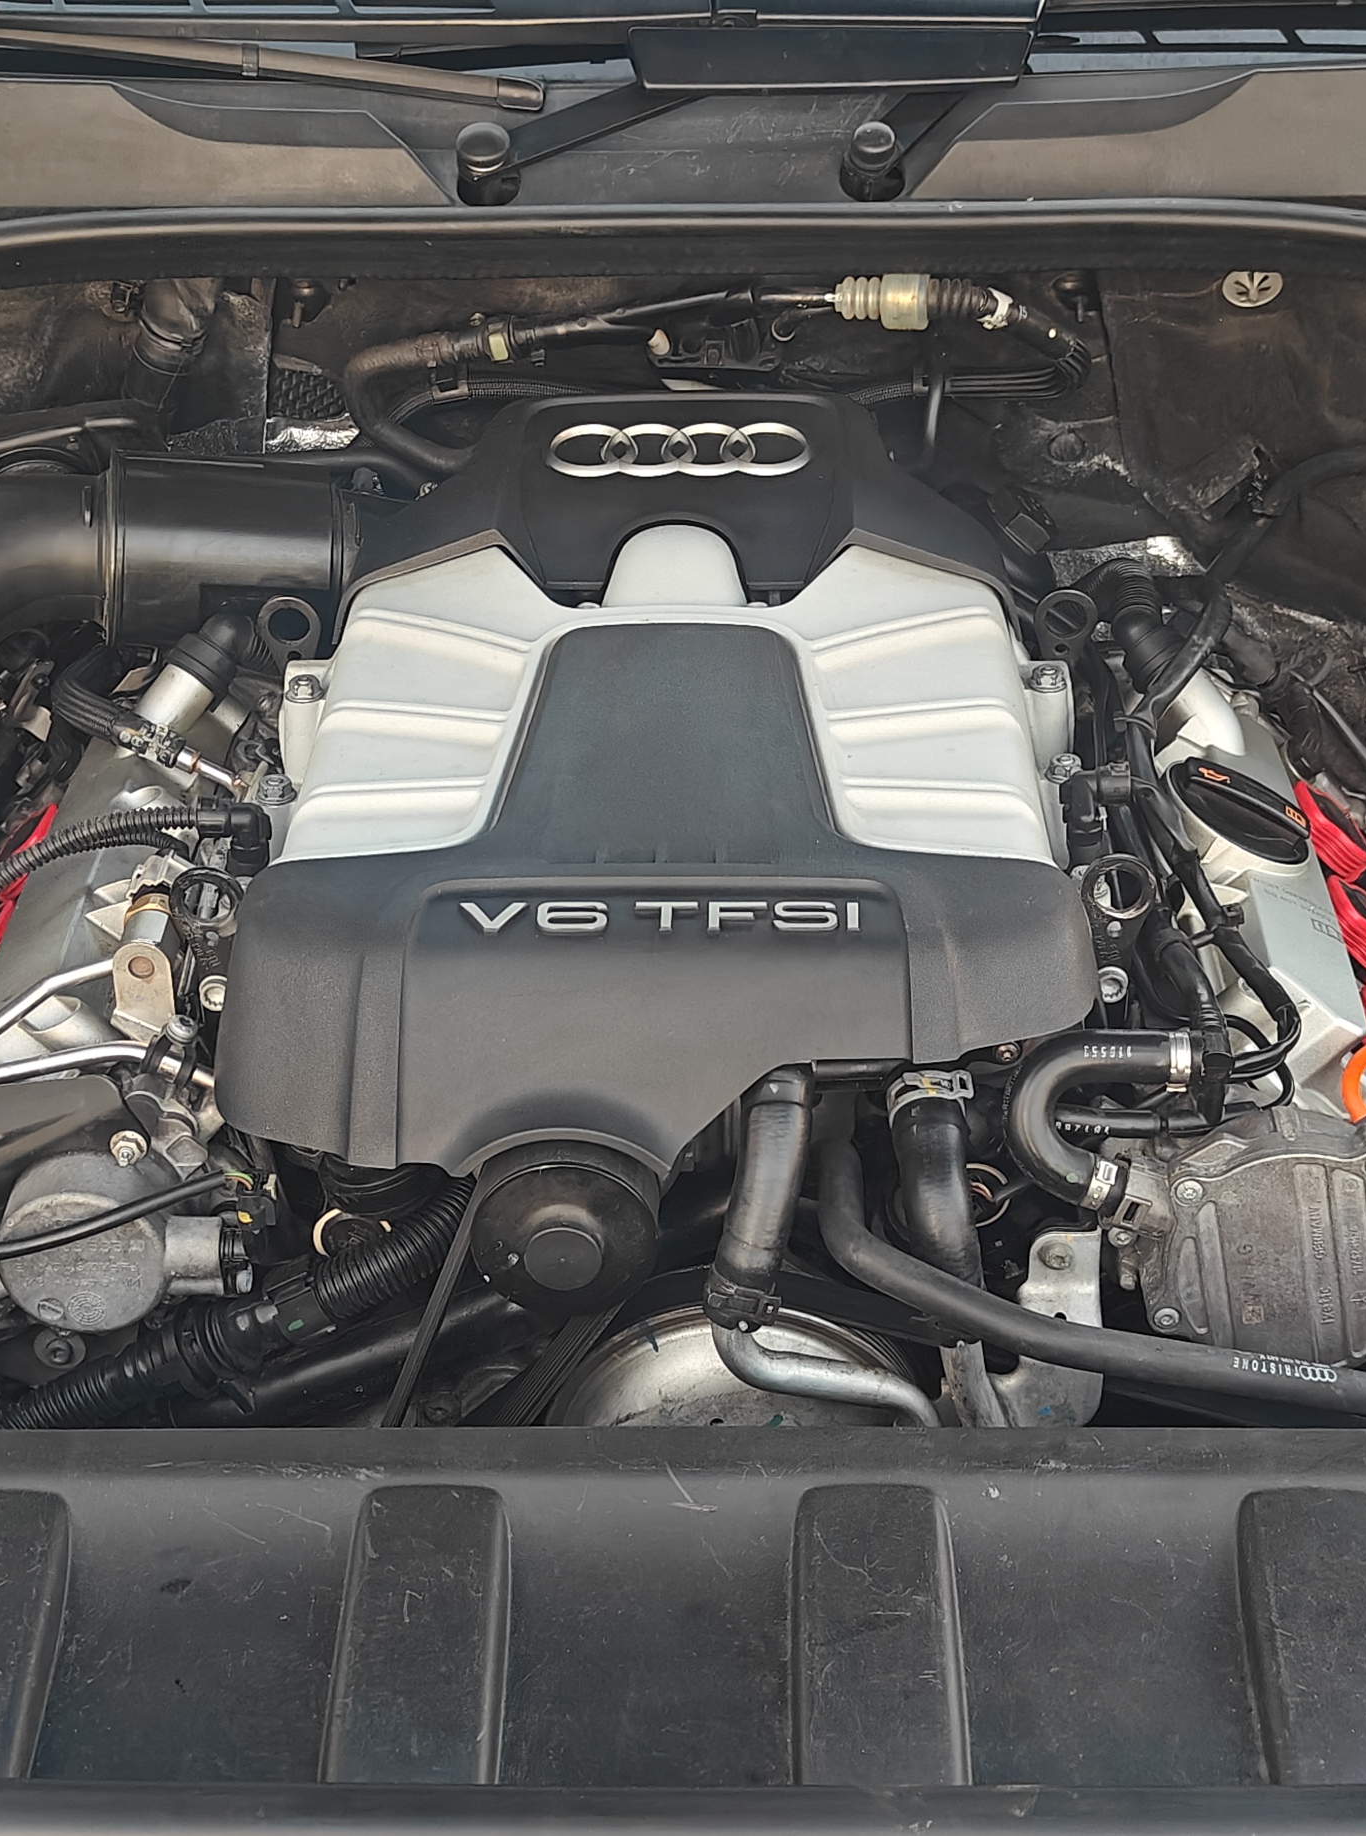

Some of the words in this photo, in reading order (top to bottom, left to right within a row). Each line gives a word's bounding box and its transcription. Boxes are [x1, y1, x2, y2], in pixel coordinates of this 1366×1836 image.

[459, 901, 608, 935] V6
[634, 901, 862, 934] TFSI
[1232, 1356, 1301, 1378] TRISTONE
